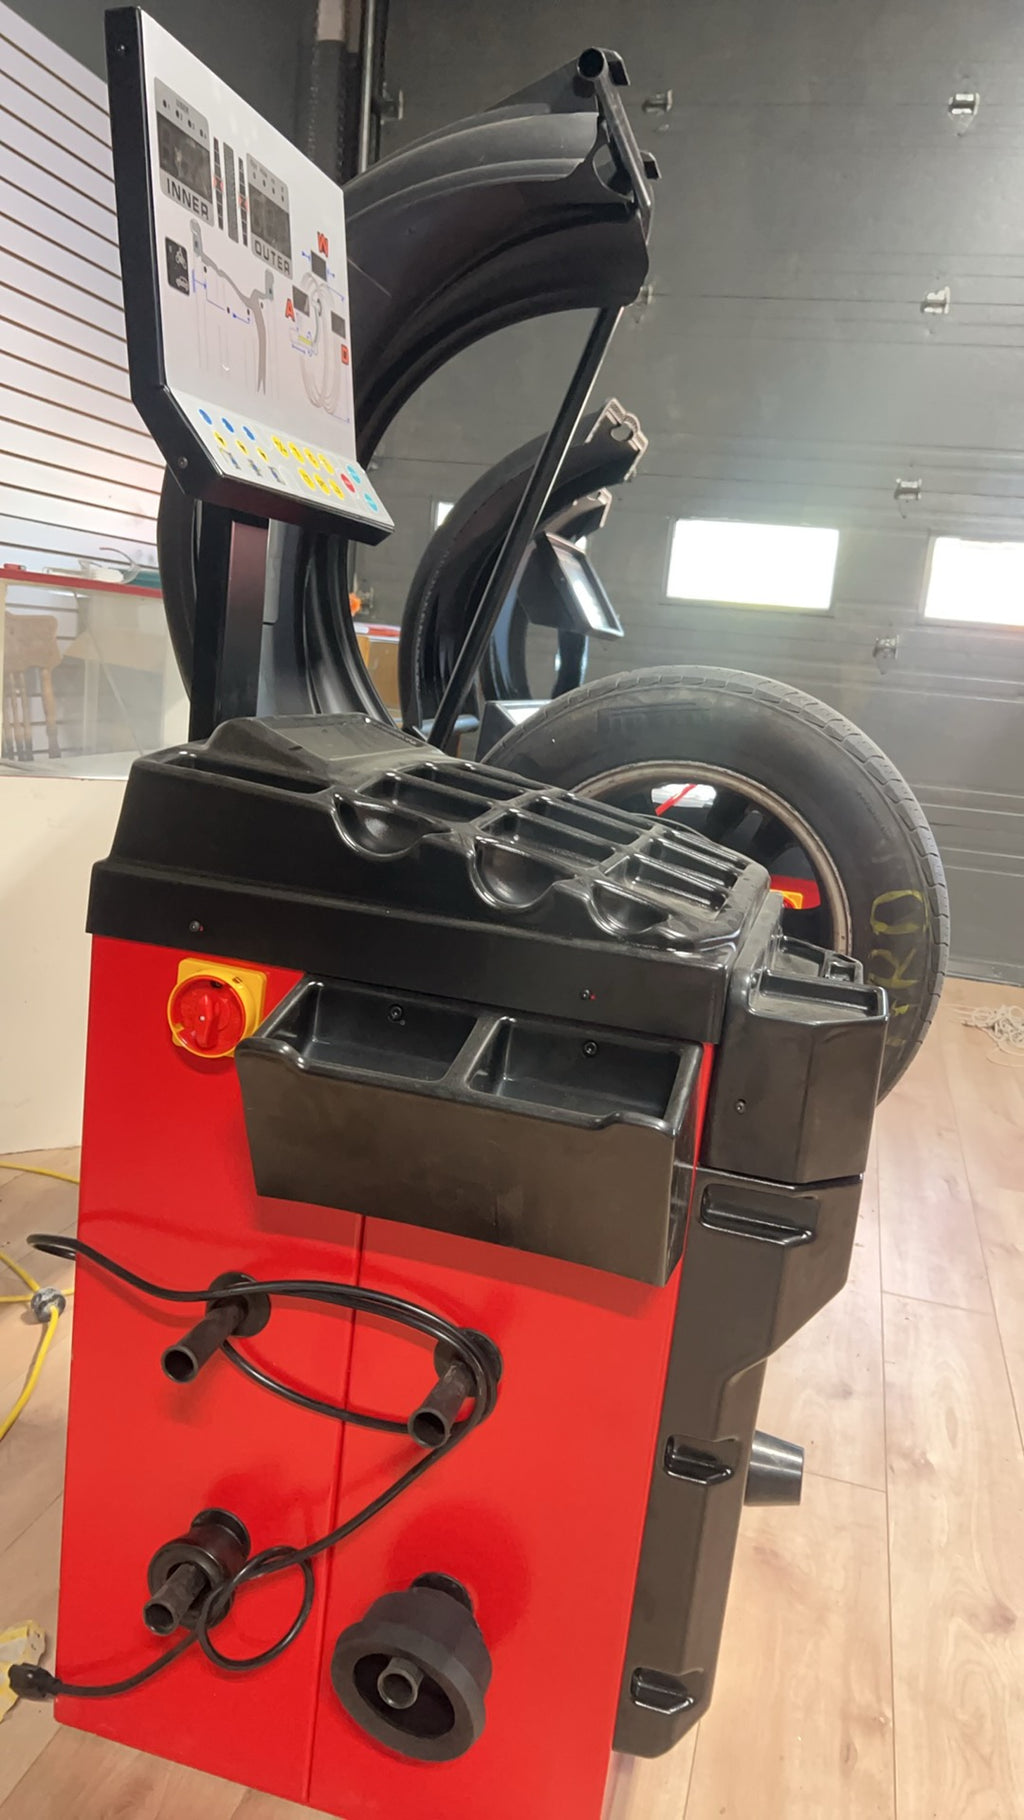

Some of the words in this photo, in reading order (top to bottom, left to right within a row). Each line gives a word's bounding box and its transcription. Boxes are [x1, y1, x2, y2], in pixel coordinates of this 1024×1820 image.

[167, 178, 209, 221] INNER
[254, 239, 290, 275] OUTER
[317, 231, 329, 258] W
[285, 298, 295, 322] A
